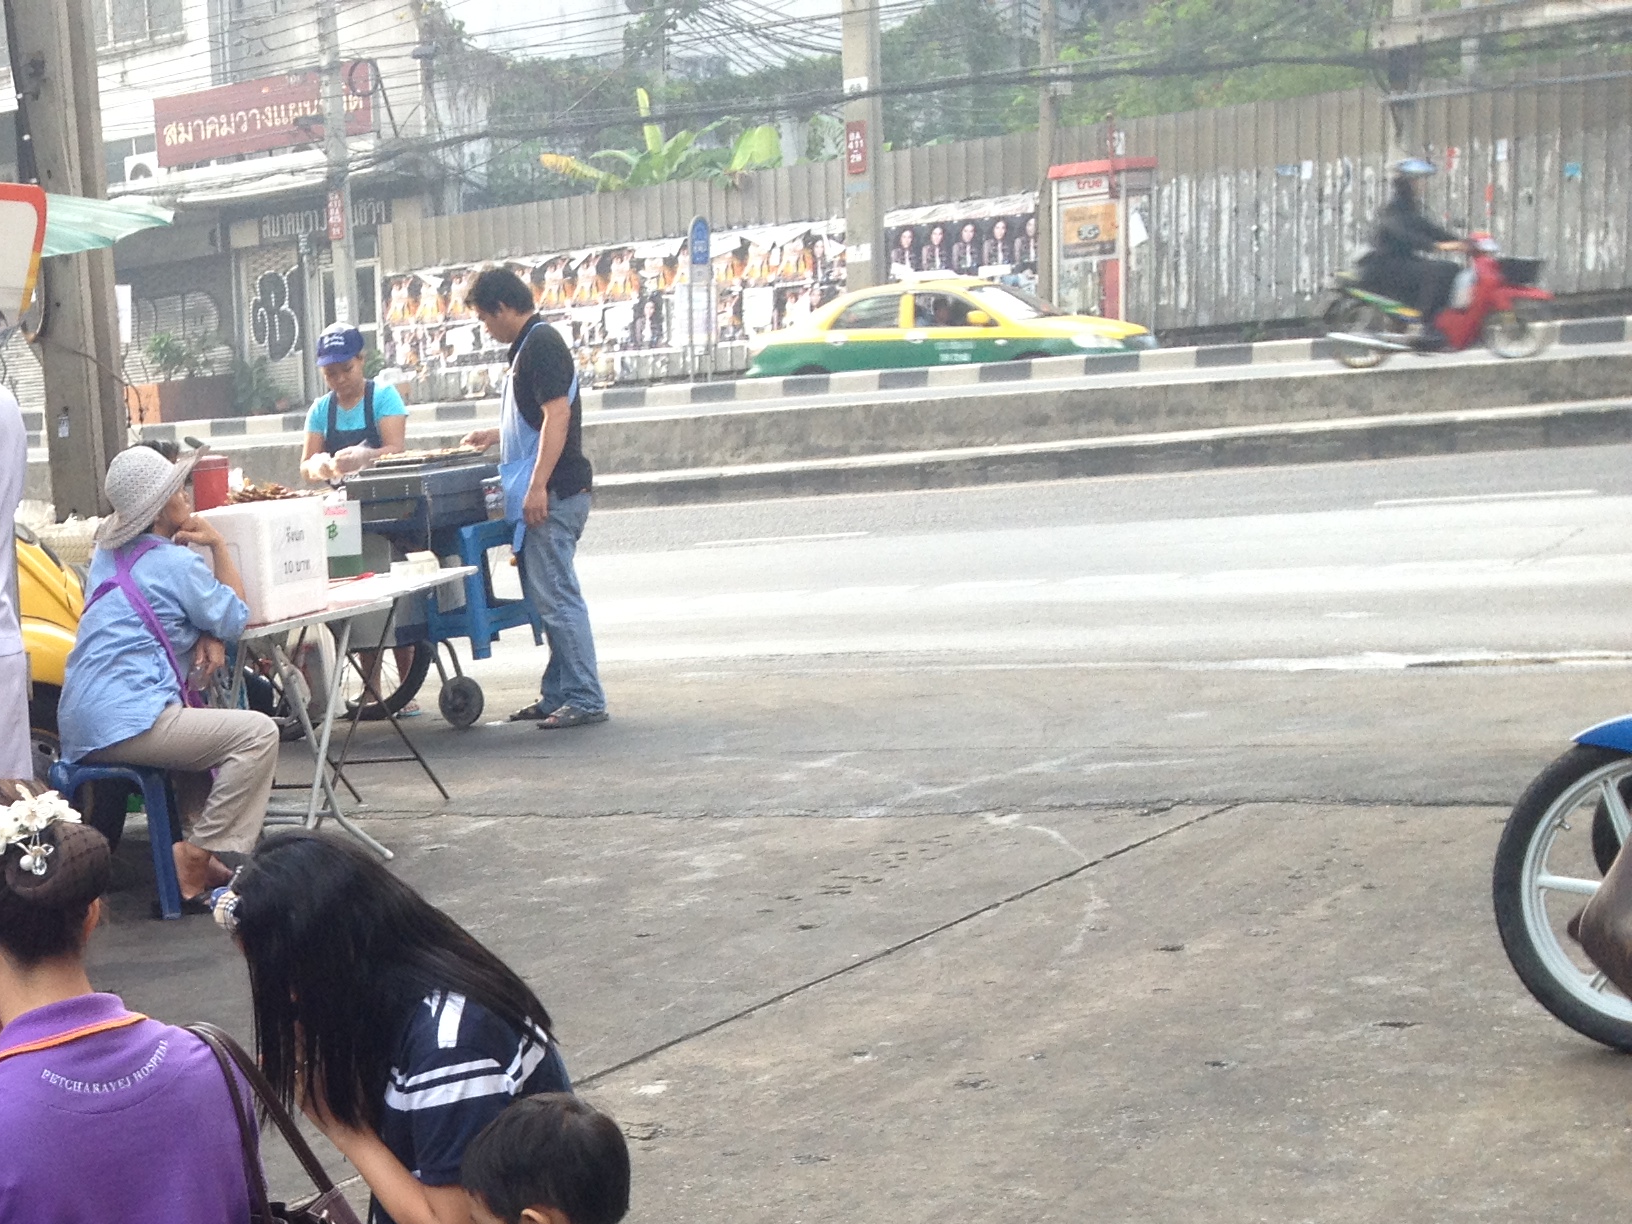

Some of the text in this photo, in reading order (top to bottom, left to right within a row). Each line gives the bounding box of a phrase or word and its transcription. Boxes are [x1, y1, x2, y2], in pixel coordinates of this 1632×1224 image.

[1076, 178, 1103, 190] true
[284, 560, 293, 574] 10
[41, 1039, 168, 1094] PETCHARAVEJ HOSPITAL
